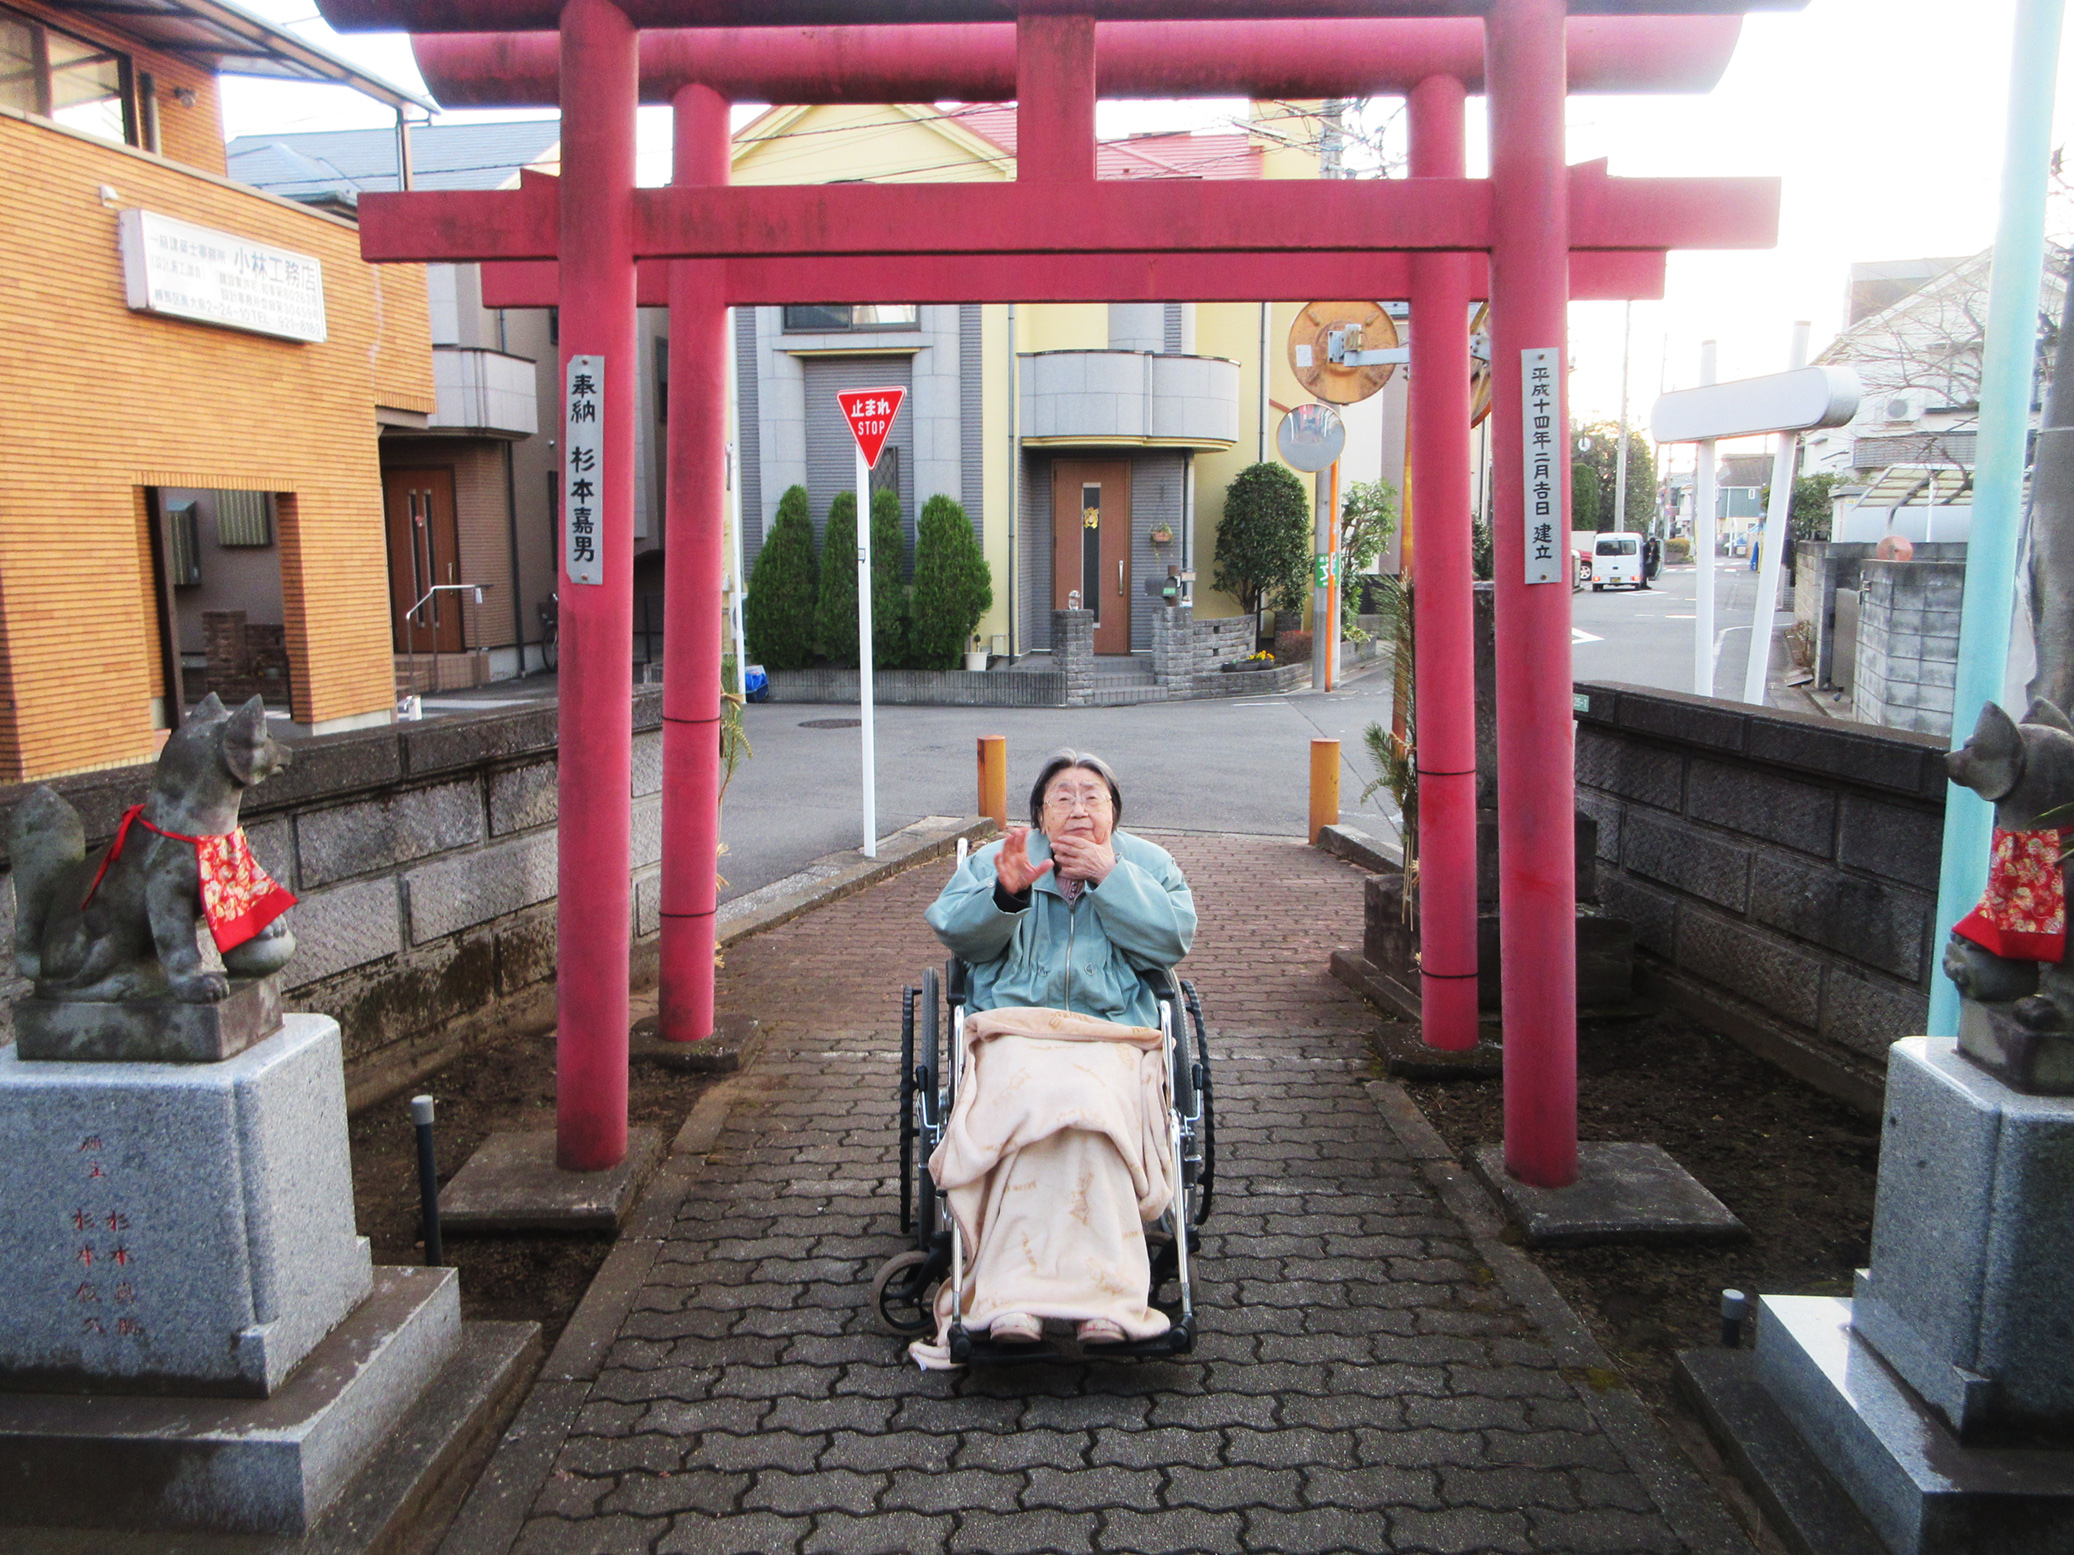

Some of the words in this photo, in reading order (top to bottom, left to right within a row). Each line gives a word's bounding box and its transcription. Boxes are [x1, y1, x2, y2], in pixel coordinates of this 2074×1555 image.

[234, 246, 316, 293] 小林工務店
[252, 310, 269, 325] TEL
[571, 373, 597, 424] 奉納
[850, 397, 891, 418] 止まれ
[857, 420, 885, 436] STOP
[1531, 367, 1552, 516] 平成十四年二月吉日
[570, 446, 596, 563] 杉本嘉男
[1532, 522, 1552, 561] 建立
